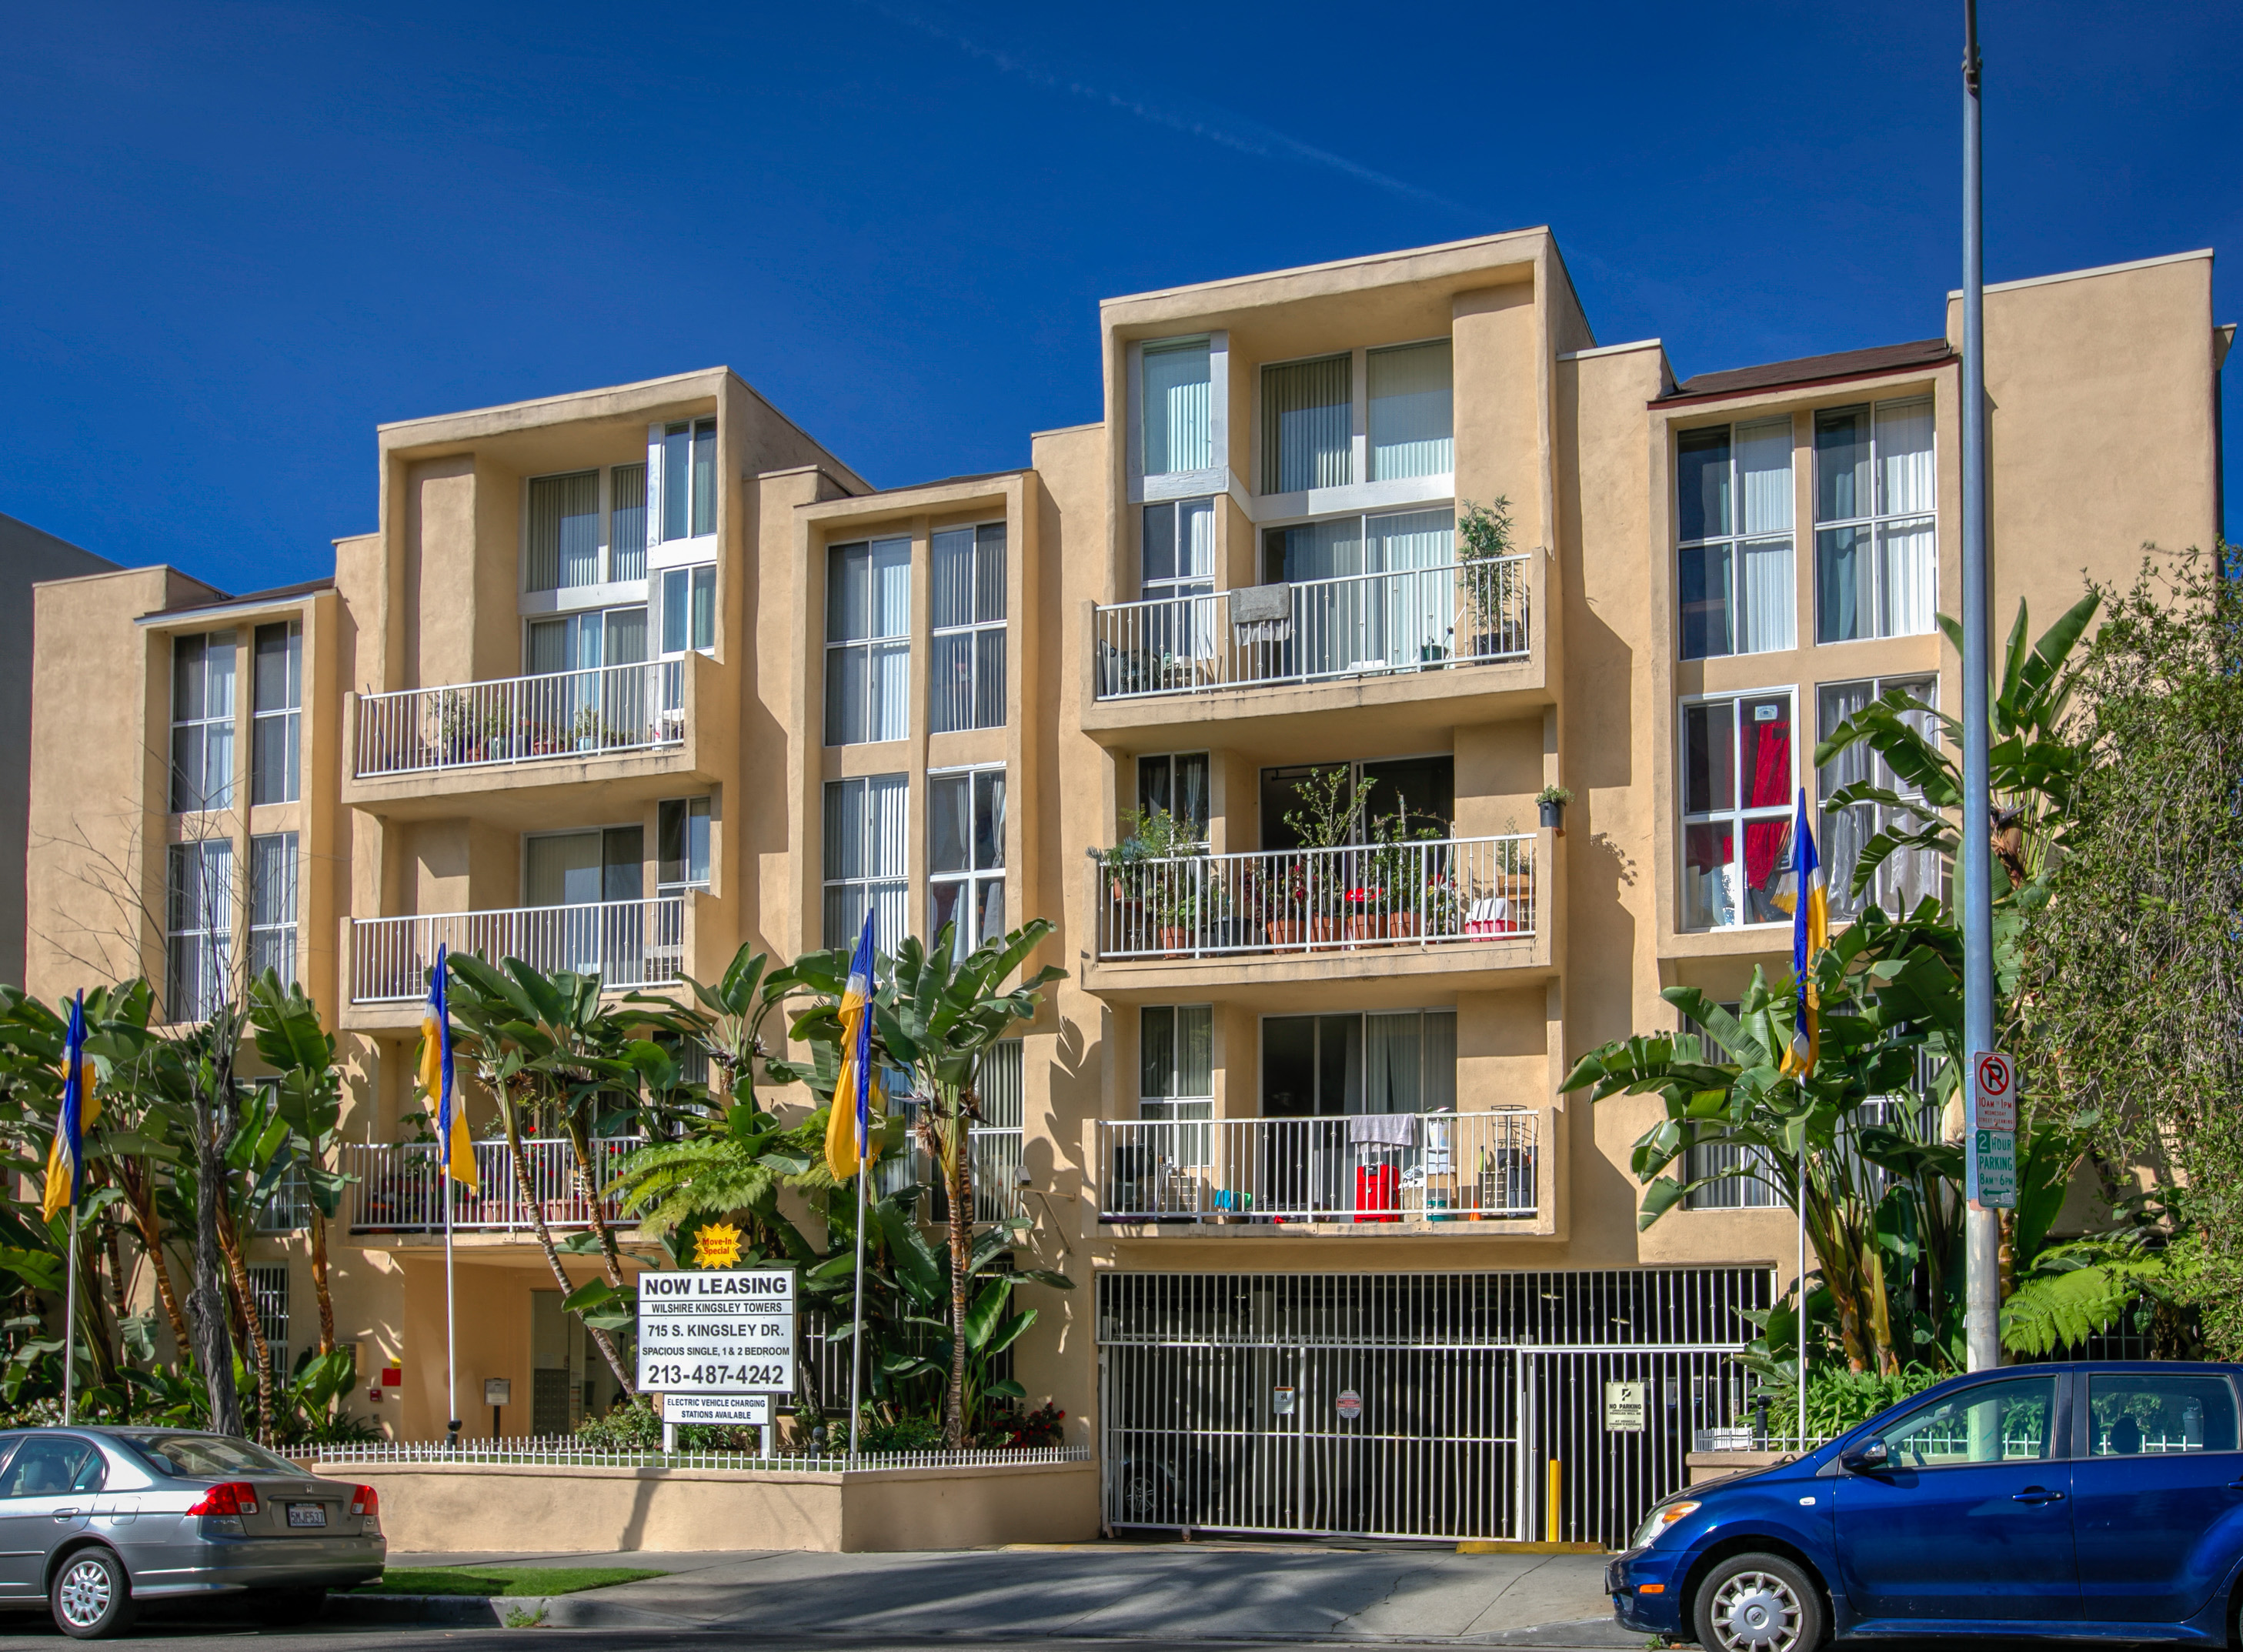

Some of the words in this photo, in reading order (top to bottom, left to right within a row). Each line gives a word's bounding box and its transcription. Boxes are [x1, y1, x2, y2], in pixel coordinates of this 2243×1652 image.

[1978, 1133, 1988, 1150] 2
[1991, 1138, 2012, 1151] HOUR
[1979, 1156, 2013, 1171] PARKING
[1980, 1173, 1994, 1185] 8AM
[2000, 1174, 2013, 1186] 6PM
[703, 1247, 729, 1257] Special
[645, 1278, 691, 1295] NOW
[698, 1277, 786, 1294] LEASING
[652, 1303, 693, 1313] WILSHIRE
[696, 1303, 741, 1313] KINGSLEY
[743, 1303, 782, 1312] TOWERS
[648, 1324, 668, 1337] 715
[672, 1324, 684, 1337] S.
[687, 1324, 756, 1337] KINGSLEY
[761, 1323, 784, 1336] DR.
[642, 1347, 684, 1356] SPACIOUS
[686, 1347, 720, 1357] SINGLE,
[745, 1347, 789, 1355] BEDROOM
[648, 1365, 783, 1384] 213-487-4242
[730, 1399, 766, 1407] CHARGING
[715, 1410, 751, 1419] AVAILABLE
